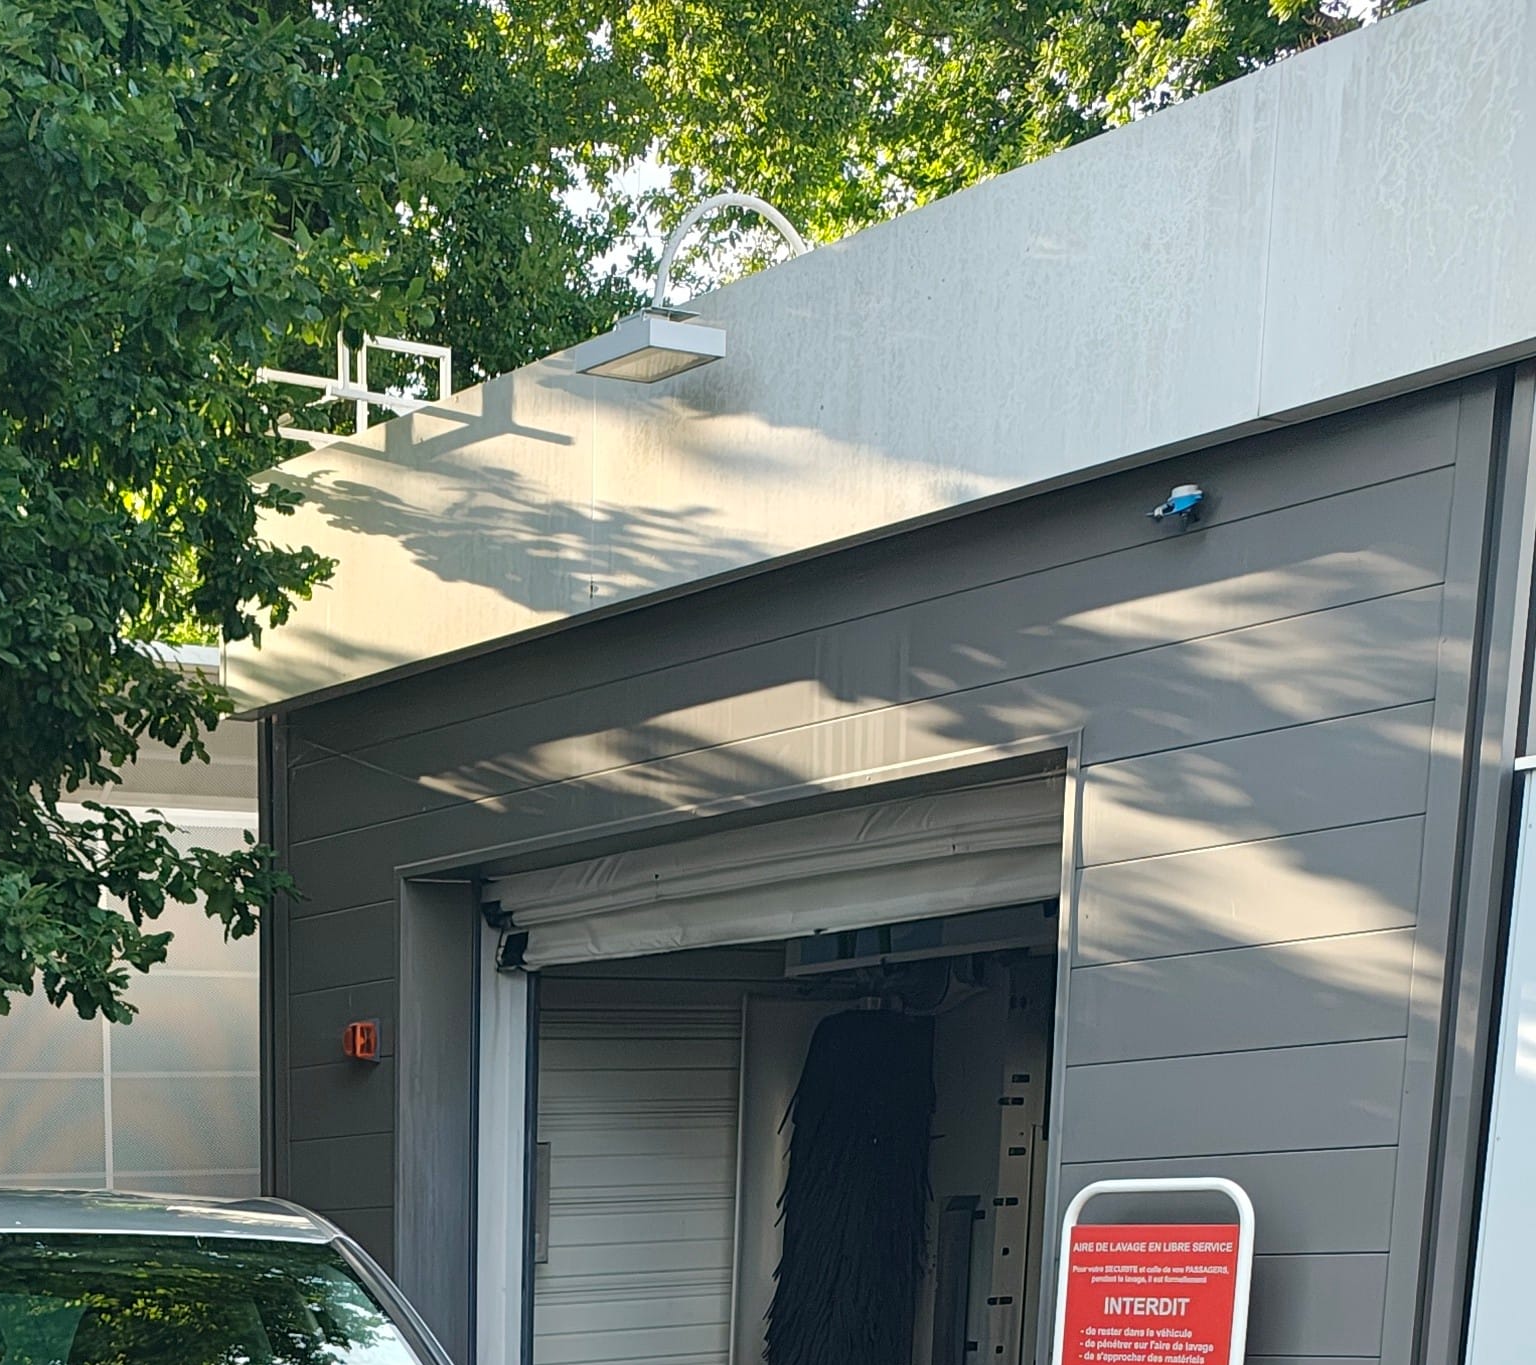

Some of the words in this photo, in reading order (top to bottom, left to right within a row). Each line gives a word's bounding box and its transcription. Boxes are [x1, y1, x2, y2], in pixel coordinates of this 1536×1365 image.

[1073, 1242, 1094, 1252] AIRE
[1095, 1242, 1109, 1252] DE
[1110, 1242, 1147, 1252] LAVAGE
[1148, 1242, 1161, 1252] EN
[1163, 1242, 1191, 1252] LIBRE
[1192, 1242, 1233, 1252] SERVICE
[1104, 1296, 1190, 1316] INTERDIT
[1085, 1326, 1097, 1336] de
[1084, 1338, 1096, 1348] de
[1133, 1341, 1149, 1350] sur
[1172, 1341, 1184, 1351] de
[1185, 1342, 1214, 1354] lavage
[1083, 1351, 1095, 1360] de
[1147, 1353, 1163, 1363] des
